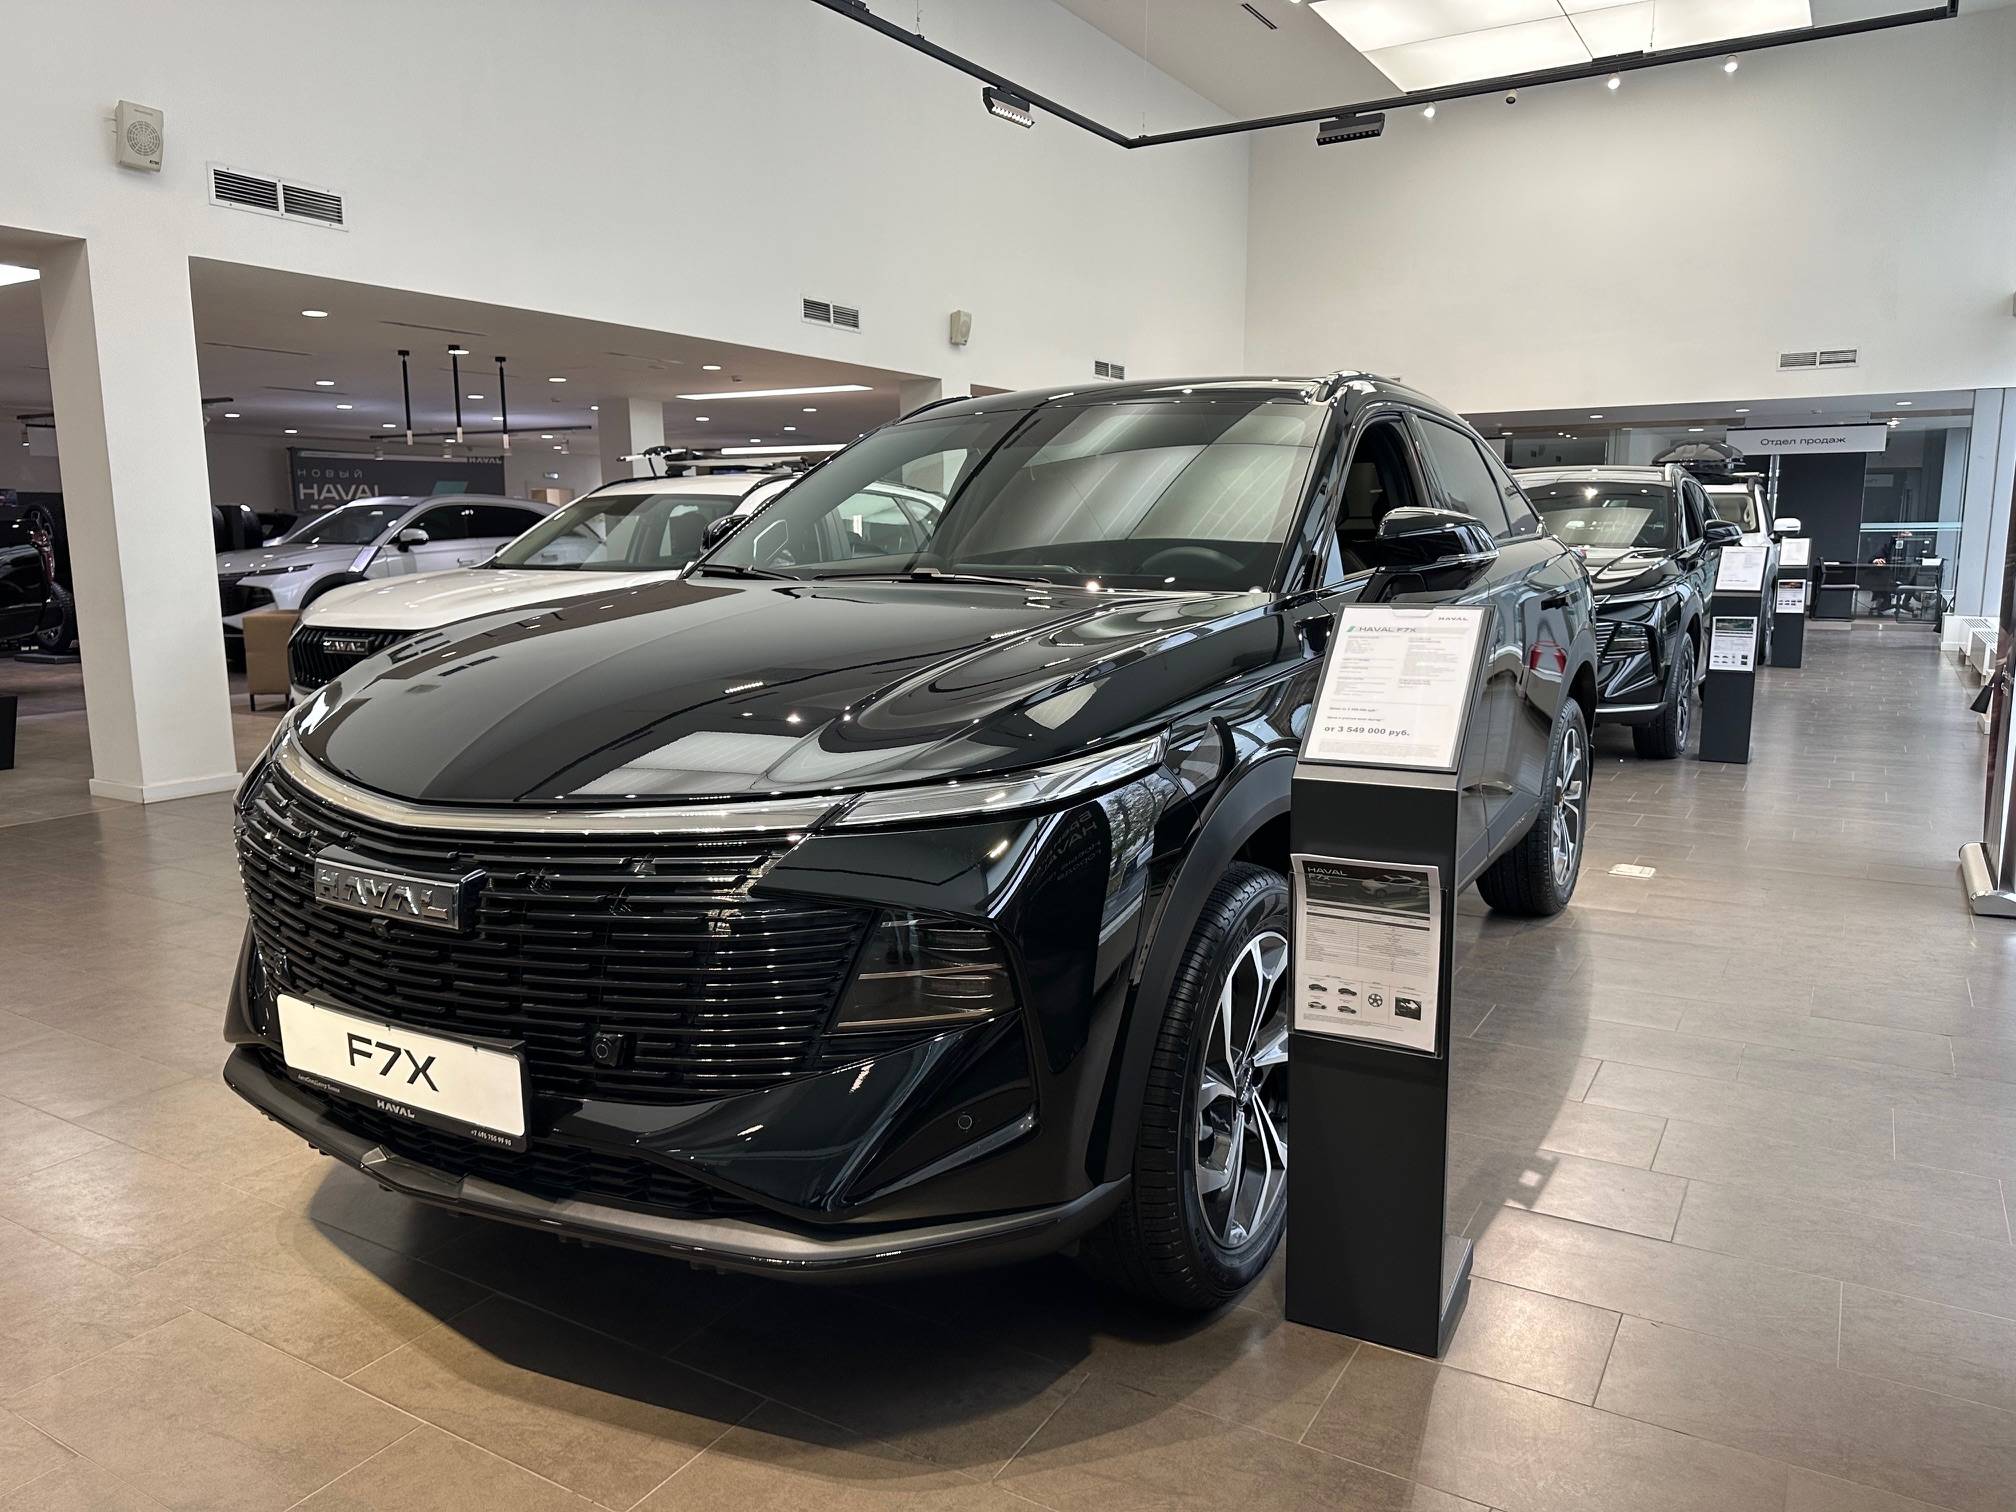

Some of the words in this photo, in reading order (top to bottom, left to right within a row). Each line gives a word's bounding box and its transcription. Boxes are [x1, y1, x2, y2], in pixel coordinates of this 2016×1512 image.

[1760, 437, 1796, 447] Отдел
[1799, 436, 1847, 446] продаж
[1367, 727, 1386, 735] 000
[1388, 728, 1411, 737] руб.
[1307, 866, 1348, 876] HAVAL
[317, 868, 448, 920] HAVAL
[346, 1032, 440, 1093] F7X
[376, 1099, 416, 1119] HAVAL
